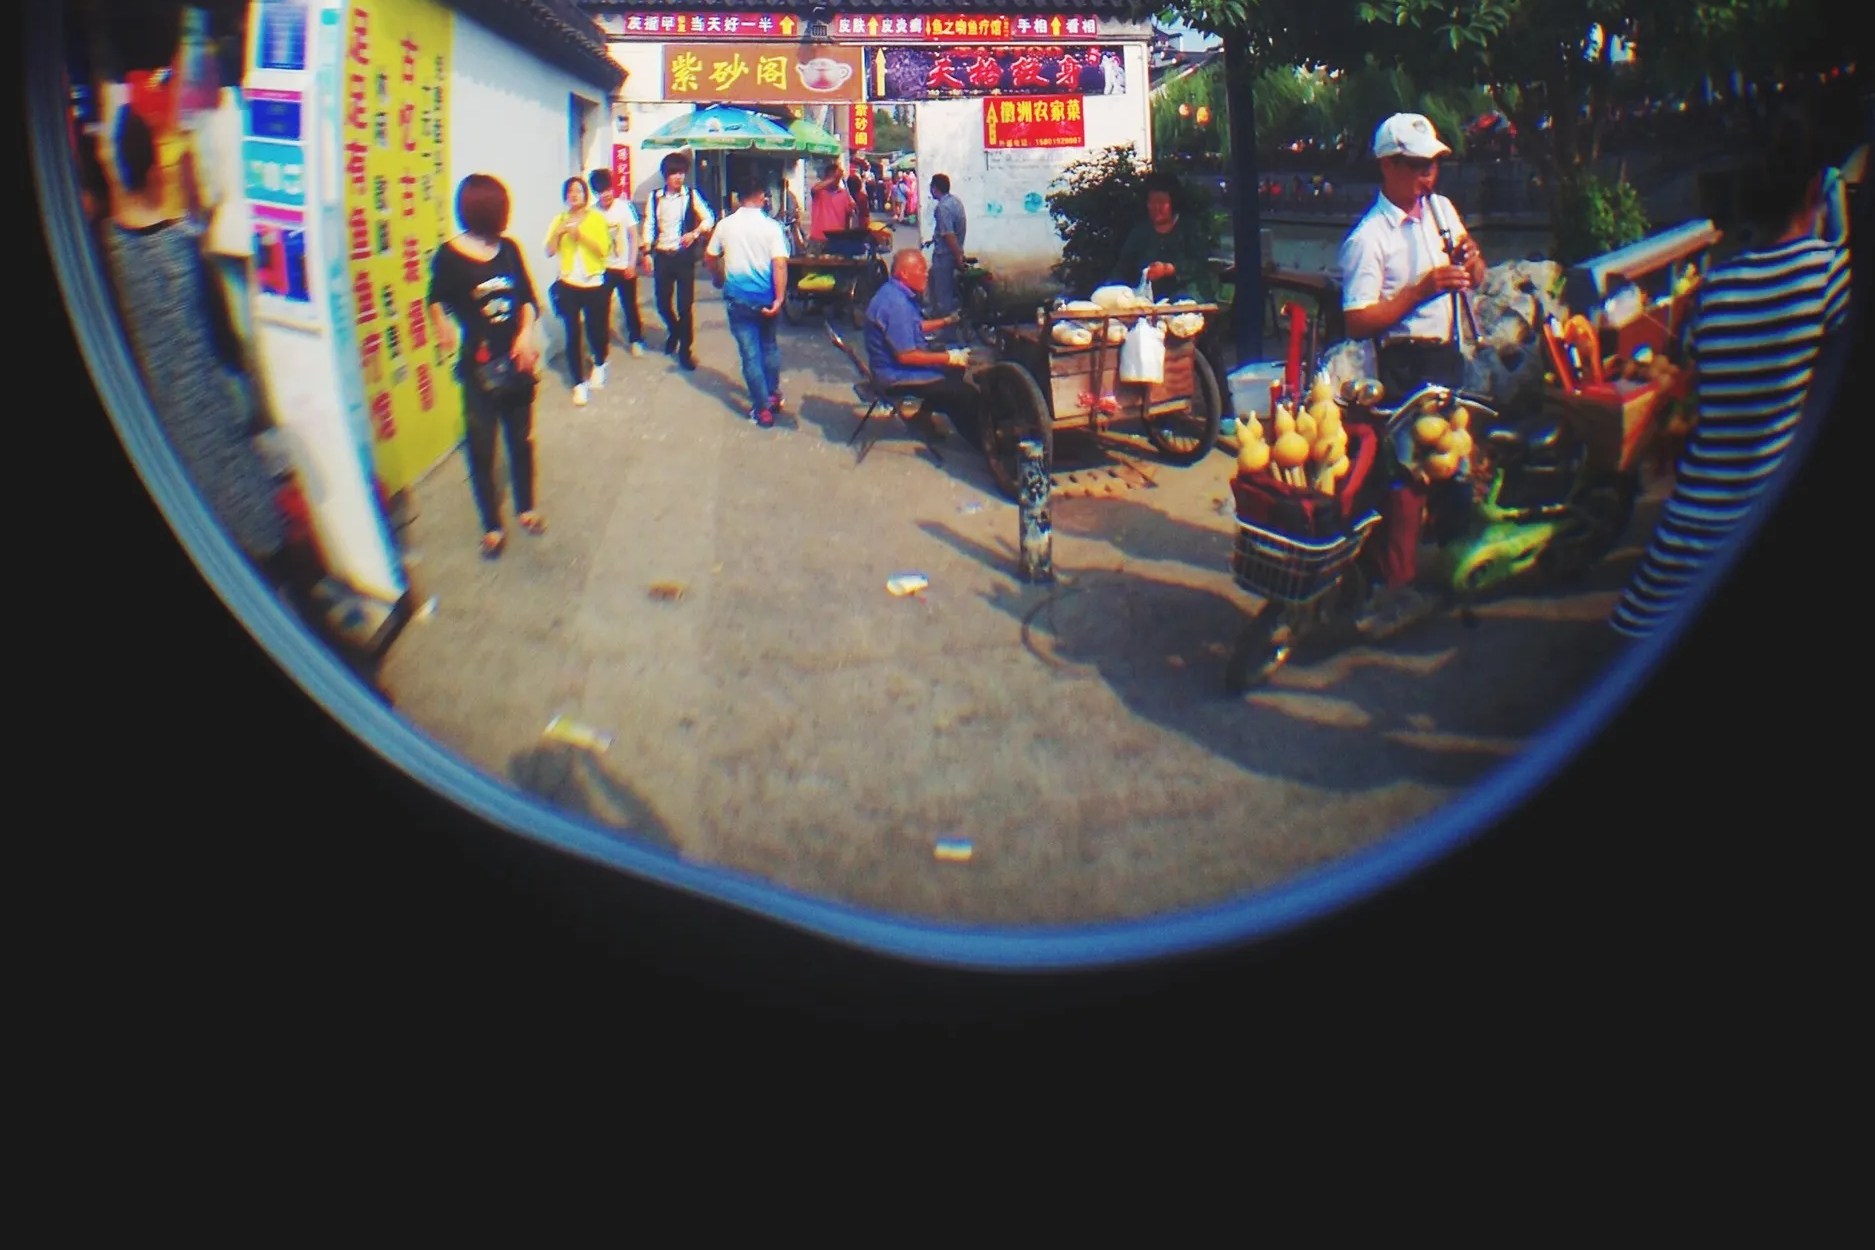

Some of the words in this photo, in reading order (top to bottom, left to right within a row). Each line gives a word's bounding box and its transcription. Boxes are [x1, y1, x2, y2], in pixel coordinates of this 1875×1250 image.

[690, 15, 774, 33] 当天好一半
[1017, 18, 1048, 34] 手相
[1065, 18, 1096, 34] 看相
[671, 51, 788, 92] 紫砂阁
[1000, 98, 1081, 124] 徽洲农家菜
